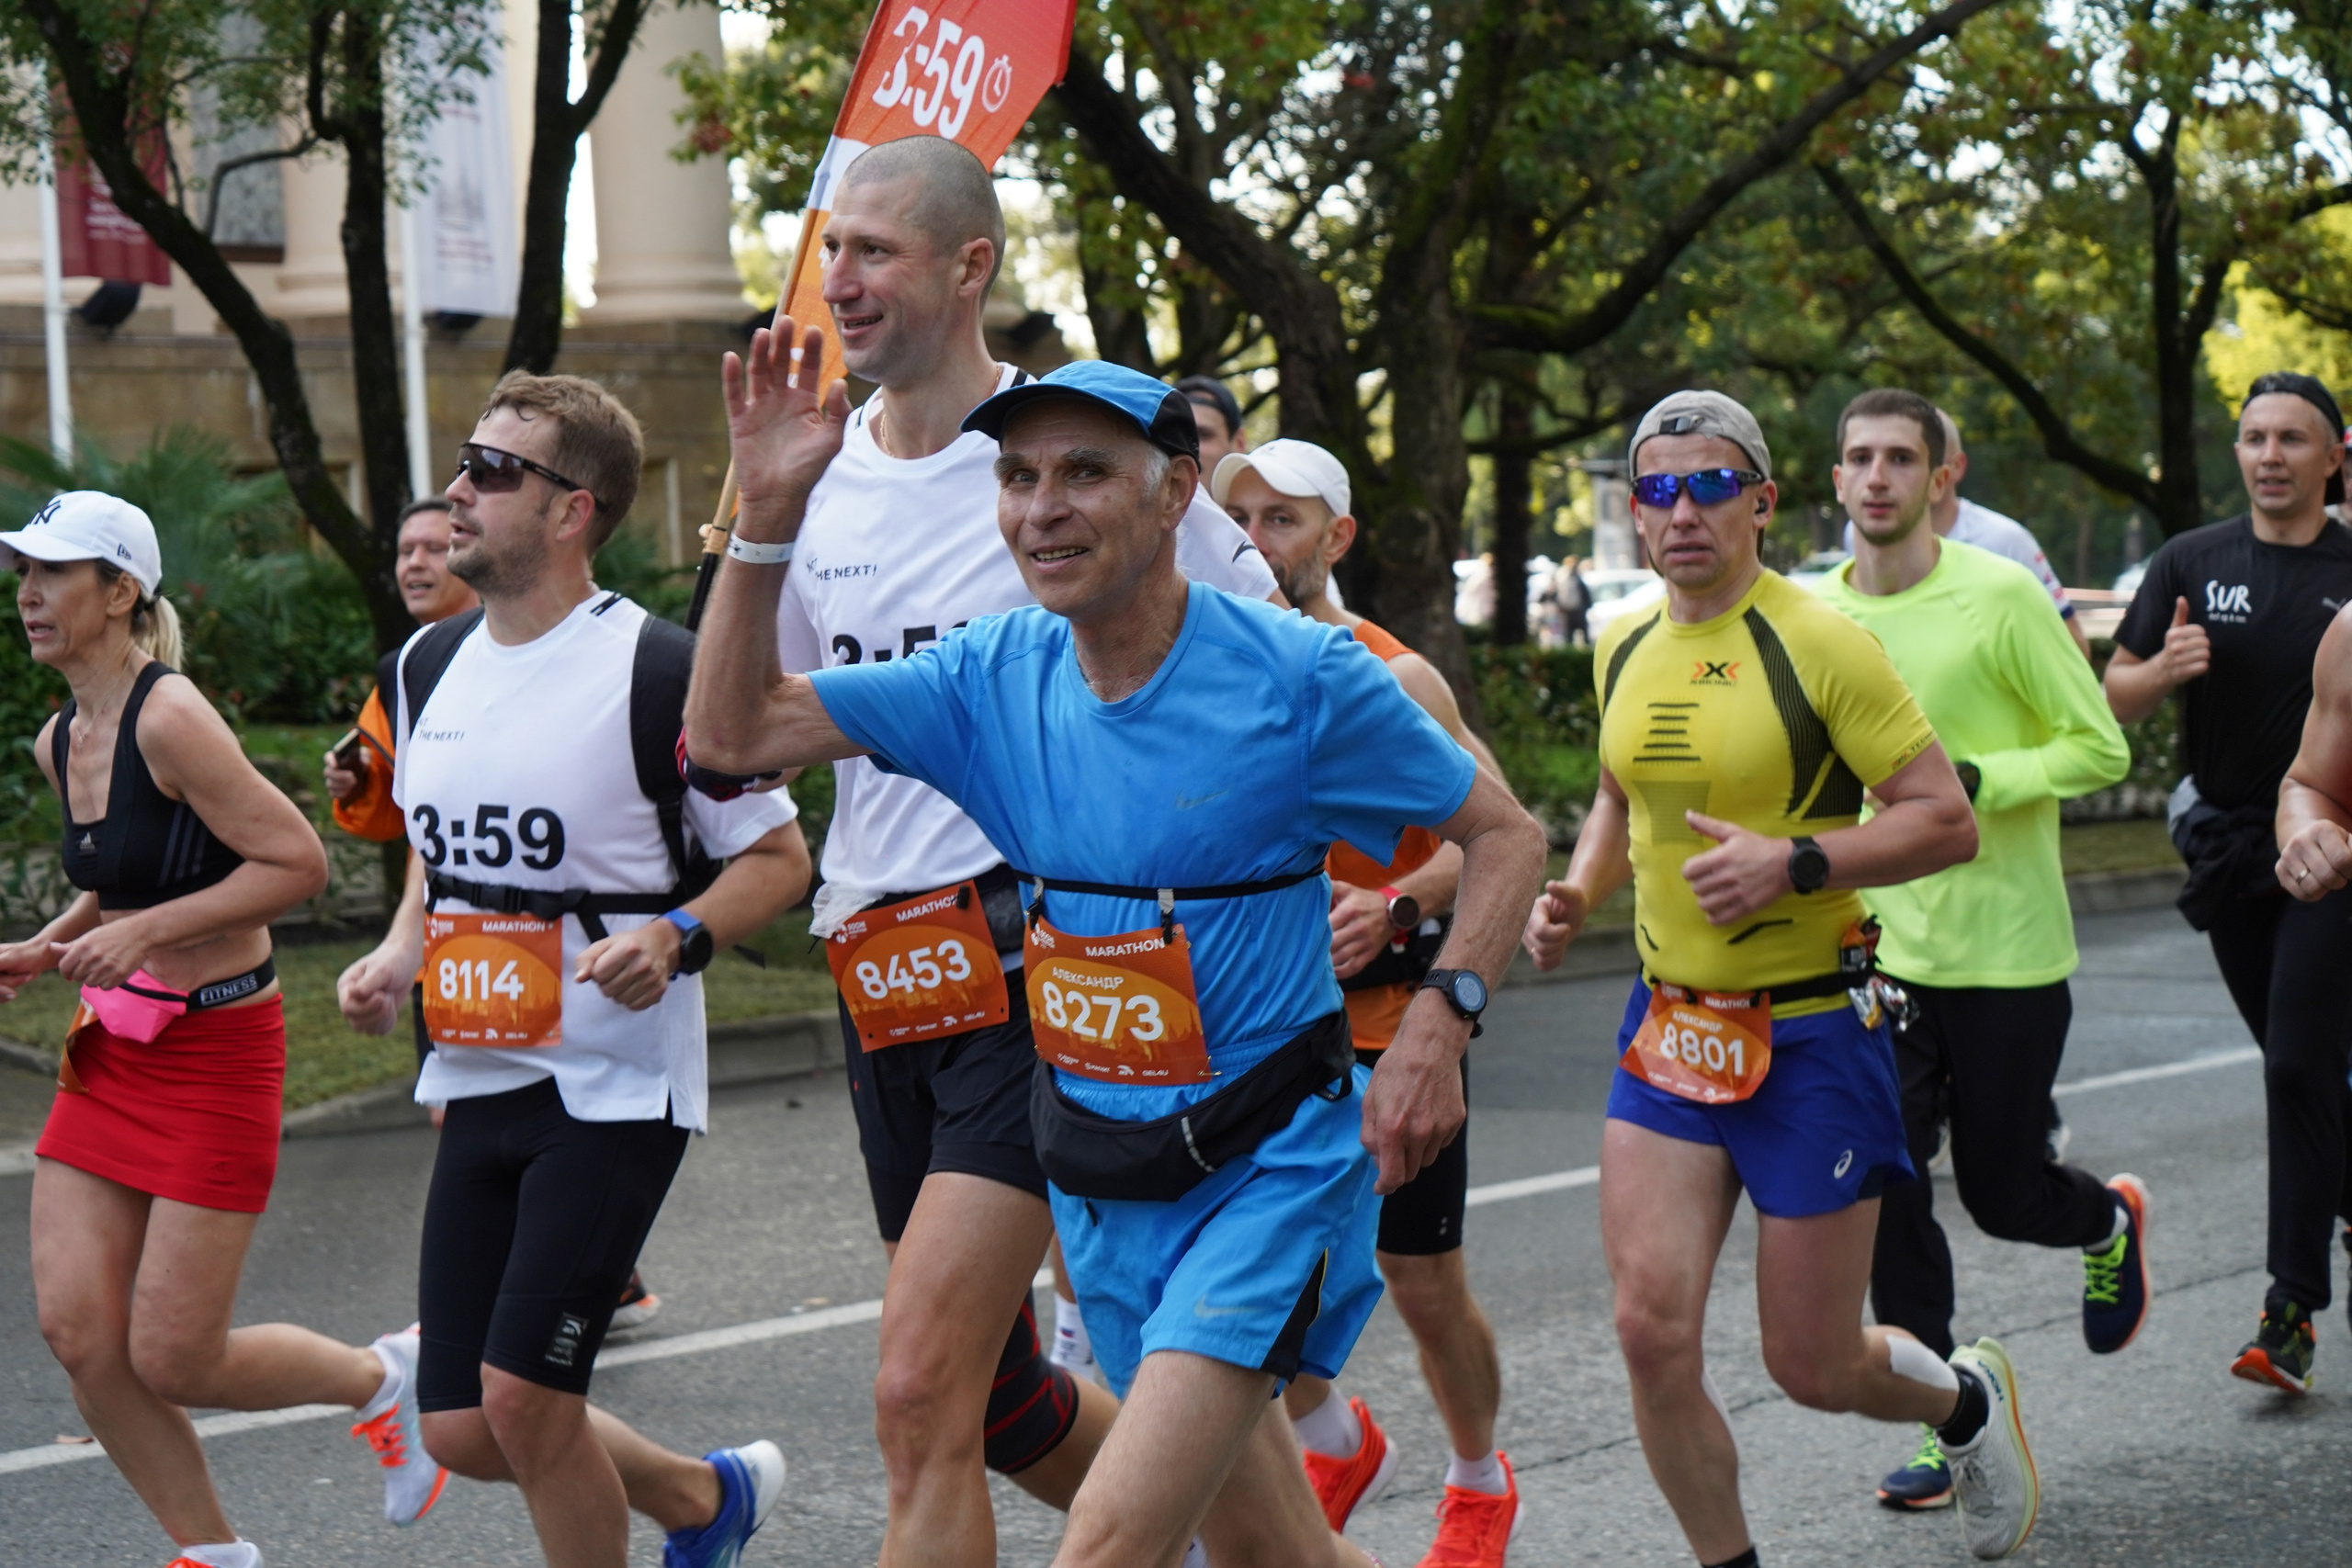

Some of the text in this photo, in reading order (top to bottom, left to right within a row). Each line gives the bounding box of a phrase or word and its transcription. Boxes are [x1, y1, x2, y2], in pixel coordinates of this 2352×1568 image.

[872, 6, 985, 139] 3:59
[2206, 580, 2253, 614] SUR
[413, 803, 566, 871] 3:59
[482, 920, 546, 933] MARATHON
[1084, 937, 1166, 957] MARATHON
[200, 976, 257, 1002] FITNESS
[439, 958, 525, 1001] 8114
[855, 939, 972, 1000] 8453
[1052, 966, 1125, 991] АЛЕКСАНДР
[1042, 981, 1164, 1042] 8273
[1659, 1022, 1745, 1077] 8801
